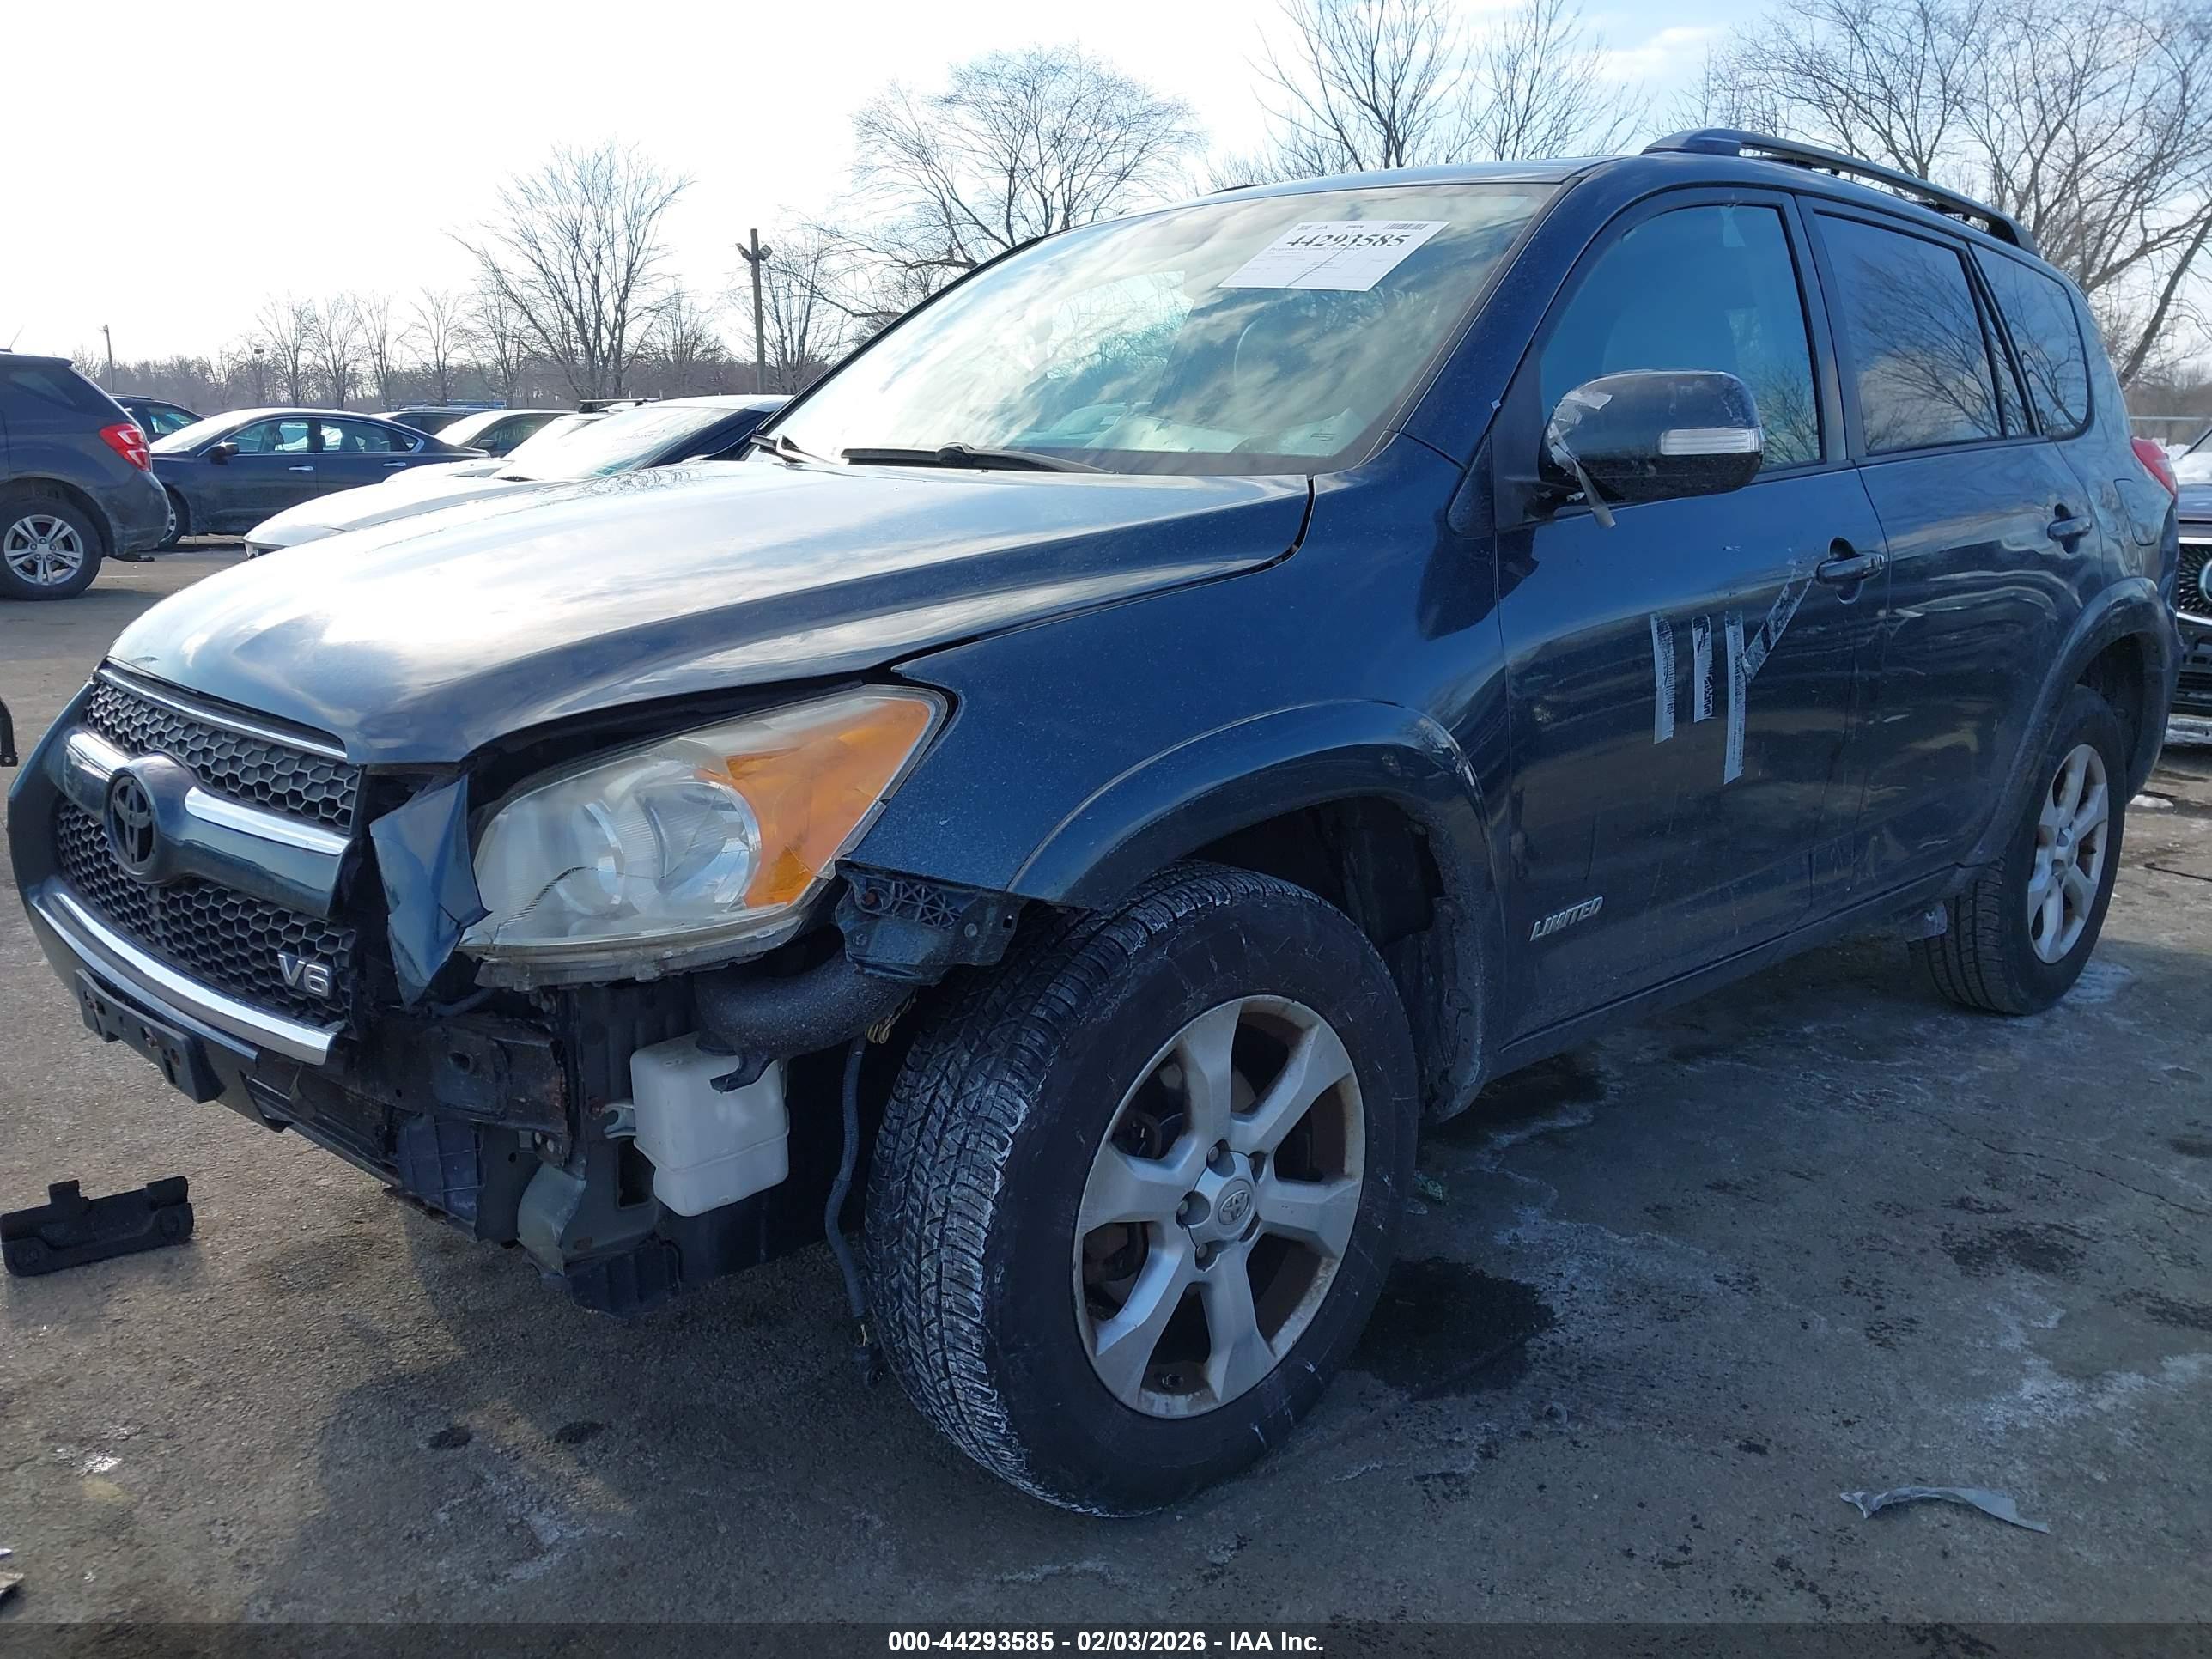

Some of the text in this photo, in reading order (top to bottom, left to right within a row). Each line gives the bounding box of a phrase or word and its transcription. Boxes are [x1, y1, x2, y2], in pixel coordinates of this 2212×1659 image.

[1285, 234, 1412, 247] 44293585
[1529, 896, 1604, 942] LIMITED
[276, 952, 330, 998] V6
